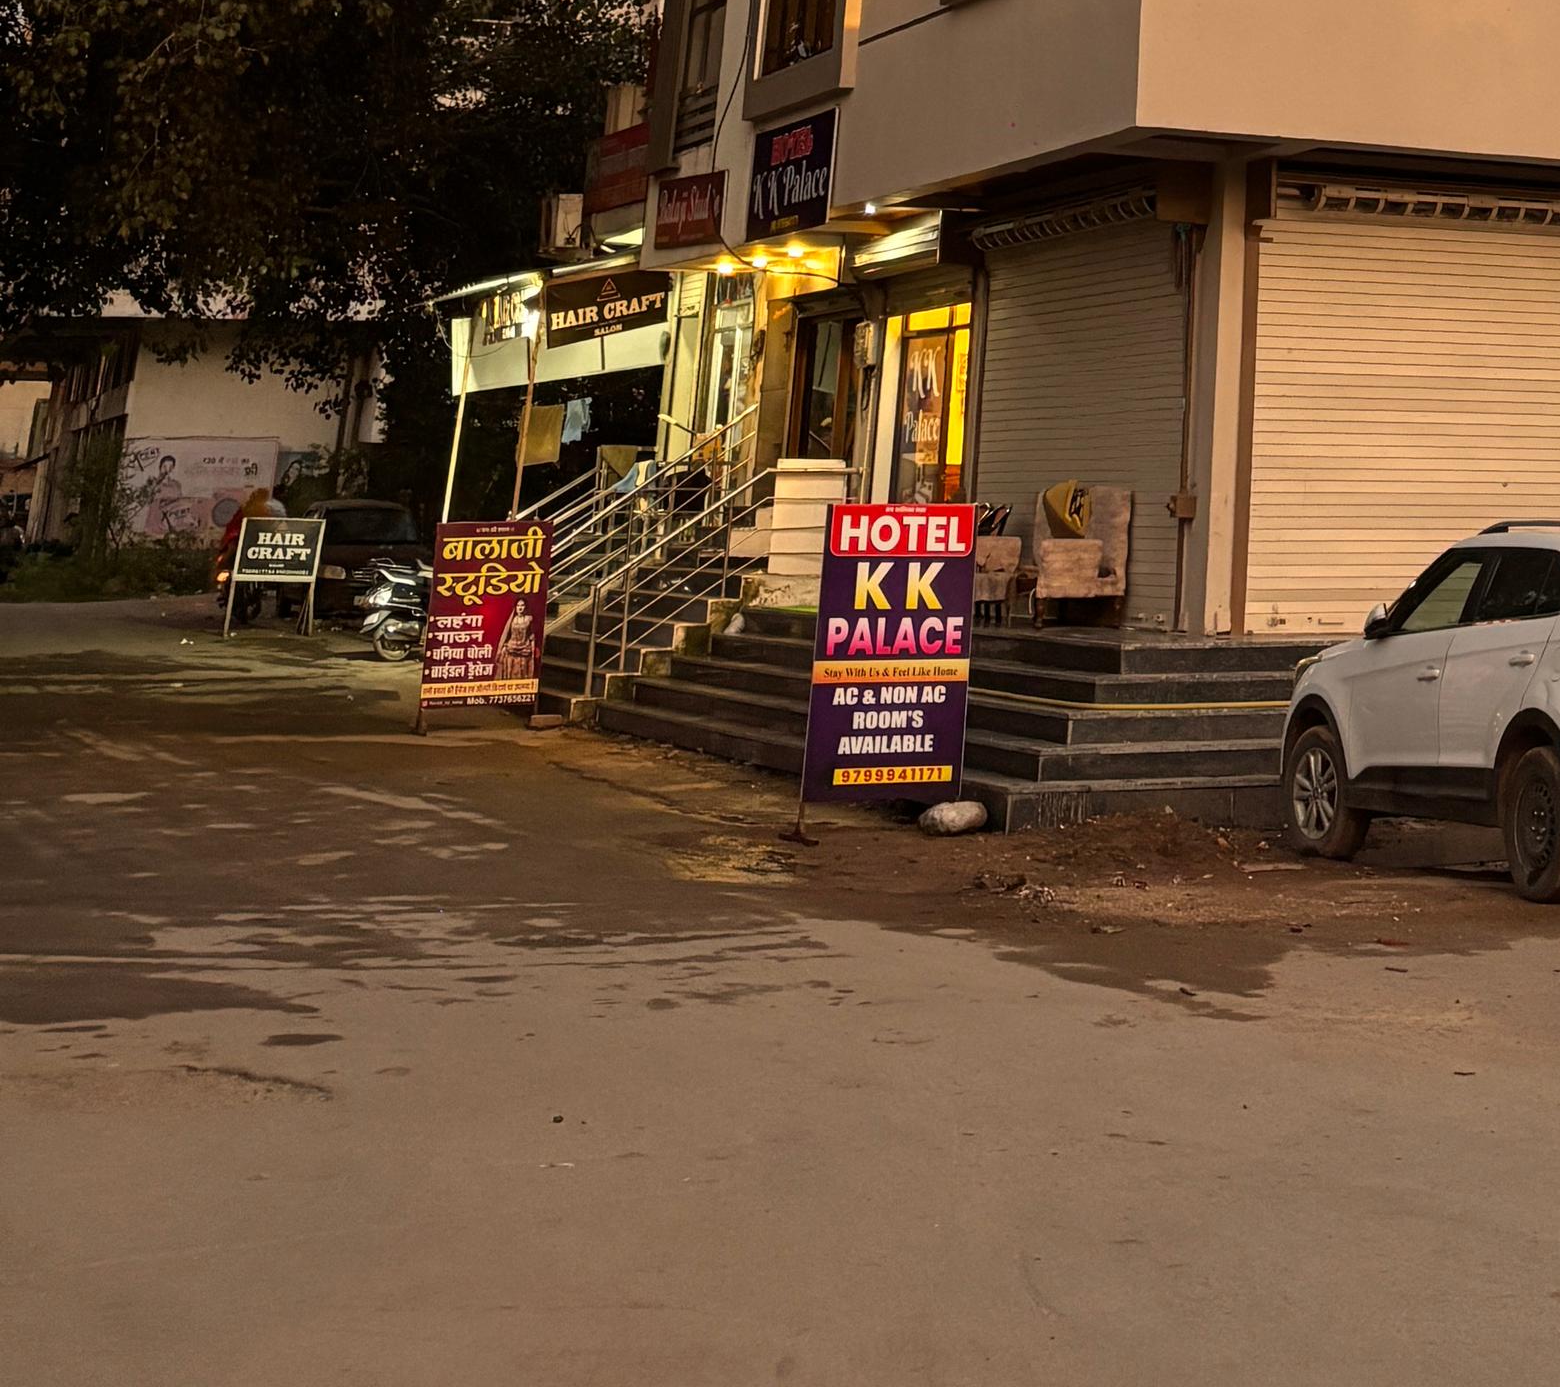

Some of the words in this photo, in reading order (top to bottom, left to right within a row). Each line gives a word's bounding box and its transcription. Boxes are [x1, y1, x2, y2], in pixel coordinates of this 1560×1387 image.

[783, 160, 828, 206] Palace
[551, 306, 599, 331] HAIR
[603, 291, 665, 320] CRAFT
[593, 323, 623, 337] SALON
[904, 409, 940, 444] Palace
[257, 532, 305, 546] HAIR
[840, 514, 966, 552] HOTEL
[443, 526, 546, 561] बालाजी
[247, 547, 311, 561] CRAFT
[436, 561, 545, 605] स्टूडियो
[435, 612, 484, 628] लहंगा
[434, 630, 485, 644] गाऊन
[826, 617, 964, 656] PALACE
[824, 667, 842, 680] Stay
[845, 667, 866, 678] With
[869, 667, 880, 677] Us
[882, 668, 890, 677] &
[893, 667, 910, 677] Feel
[913, 666, 931, 677] Like
[933, 666, 958, 676] Home
[466, 697, 488, 705] Mob.
[832, 687, 859, 706] AC
[862, 689, 876, 705] &
[880, 686, 918, 705] NON
[920, 685, 947, 704] AC
[852, 710, 924, 730] ROOM'S
[837, 734, 934, 755] AVAILABLE
[841, 767, 943, 783] 9799941171
